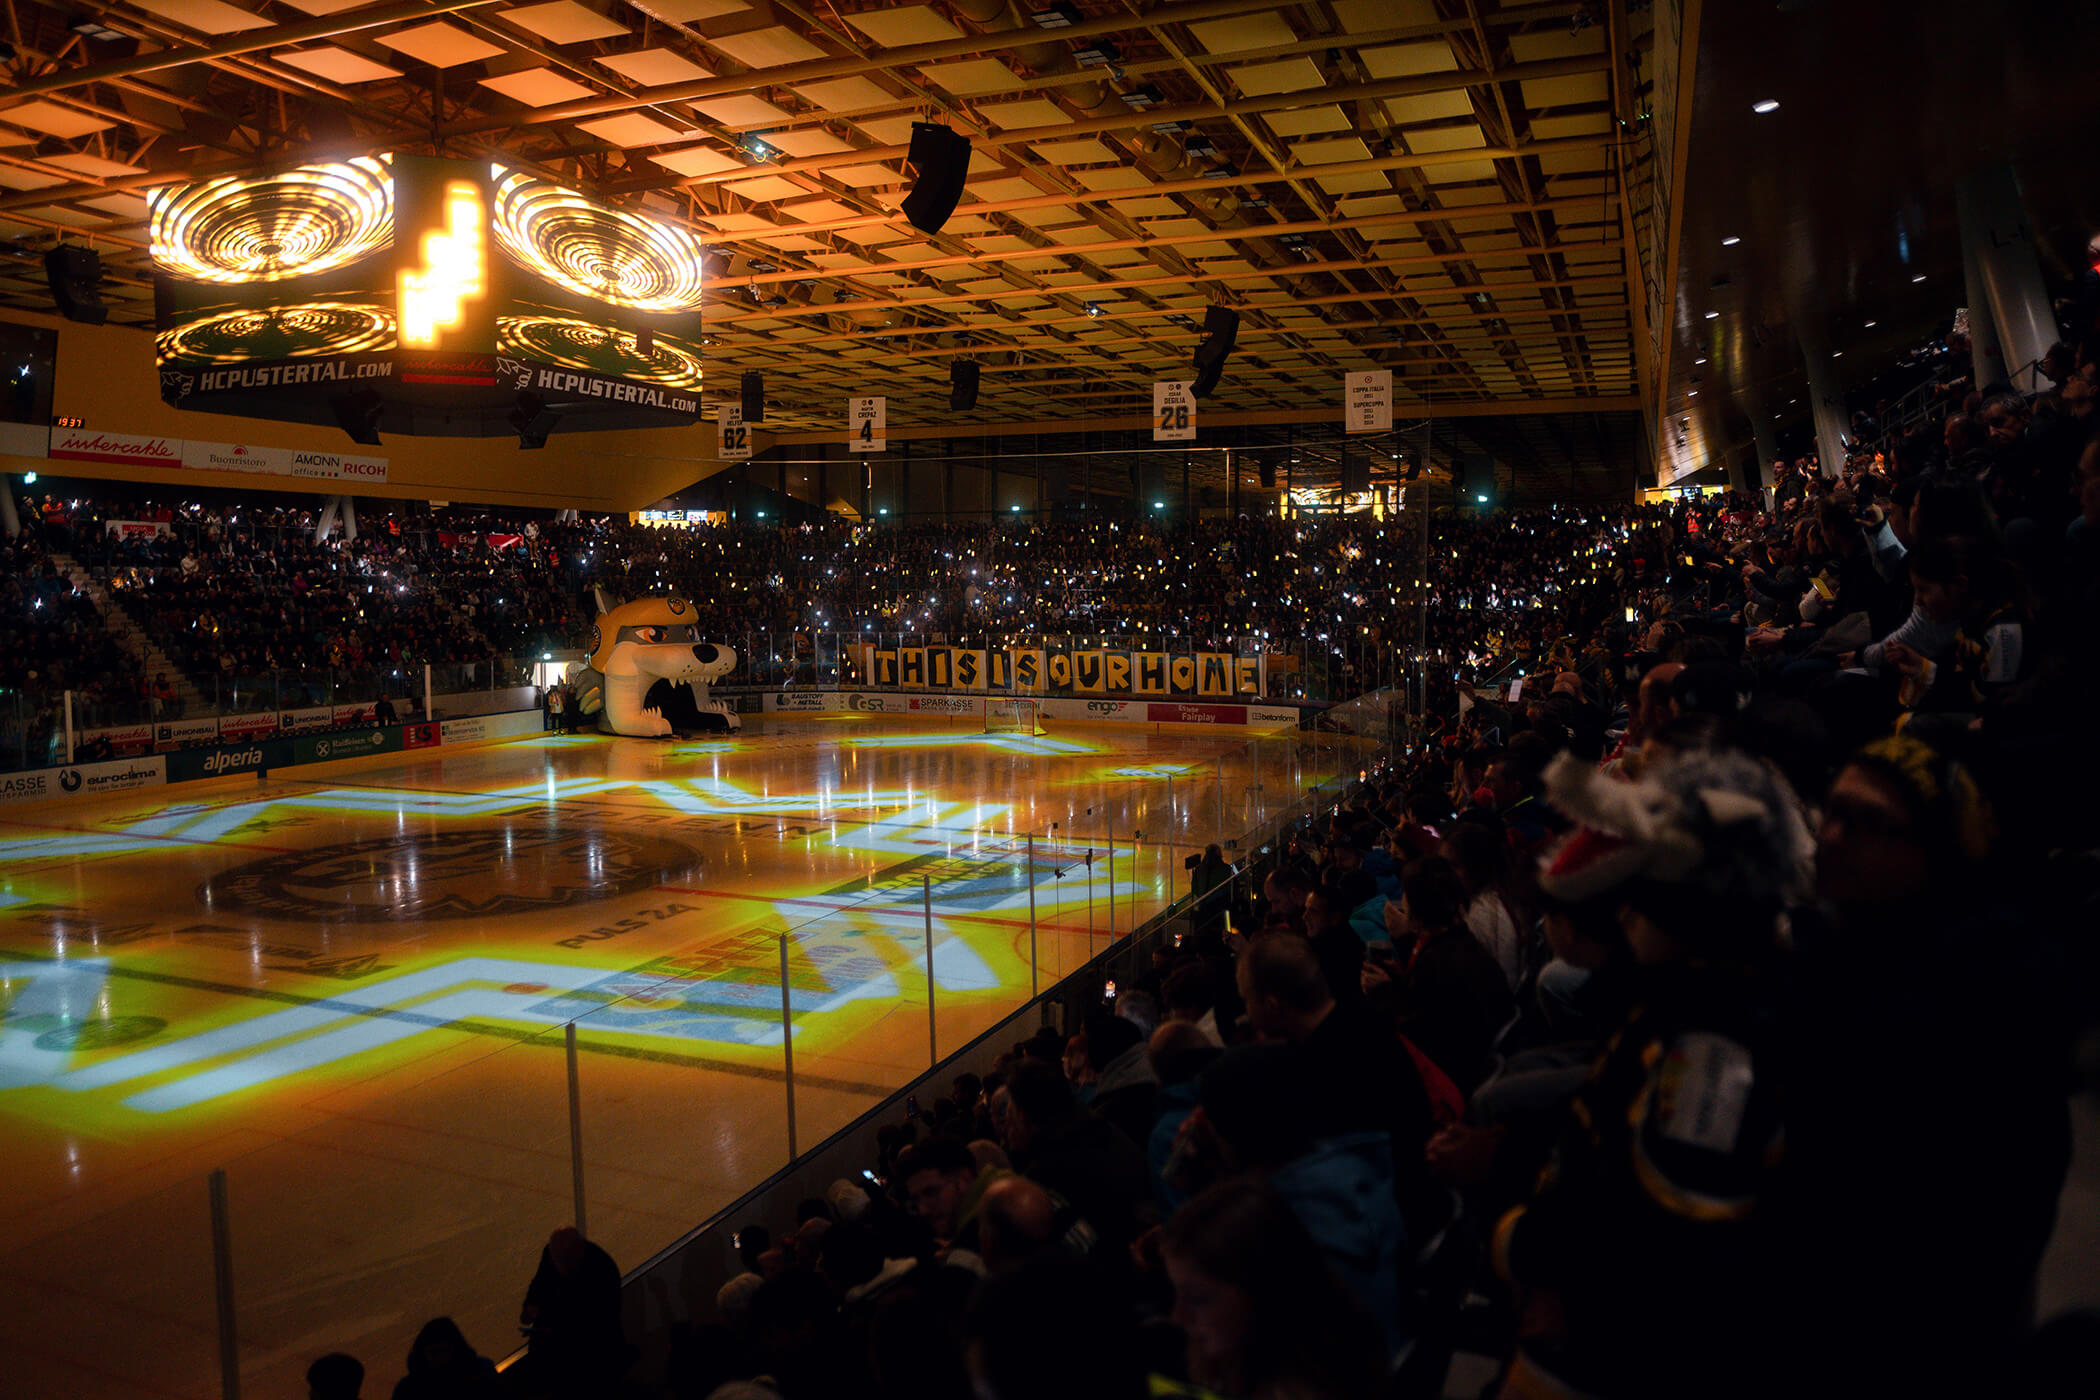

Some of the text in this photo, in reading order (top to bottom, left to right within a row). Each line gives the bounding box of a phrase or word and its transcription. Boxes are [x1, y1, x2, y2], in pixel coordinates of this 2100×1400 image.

[200, 360, 393, 392] HCPUSTERTAL.COM
[537, 368, 698, 414] HCPUSTERTAL.COM
[1161, 406, 1189, 431] 26
[724, 428, 748, 450] 62
[860, 419, 873, 443] 4
[60, 432, 174, 457] intercable
[209, 453, 267, 468] Buonristoro
[295, 453, 341, 468] AMONN
[343, 462, 386, 477] RICOH
[876, 651, 980, 687] THIS
[1048, 654, 1133, 690] OUR
[1140, 653, 1258, 694] HOME
[920, 698, 973, 709] SPARKASSE
[1087, 701, 1118, 716] engo
[1181, 712, 1216, 724] Fairplay
[1261, 713, 1296, 723] betonform
[173, 726, 215, 738] UNIONBAU
[203, 746, 263, 775] alperia
[87, 765, 156, 785] euroclima
[556, 903, 702, 950] PULS 24
